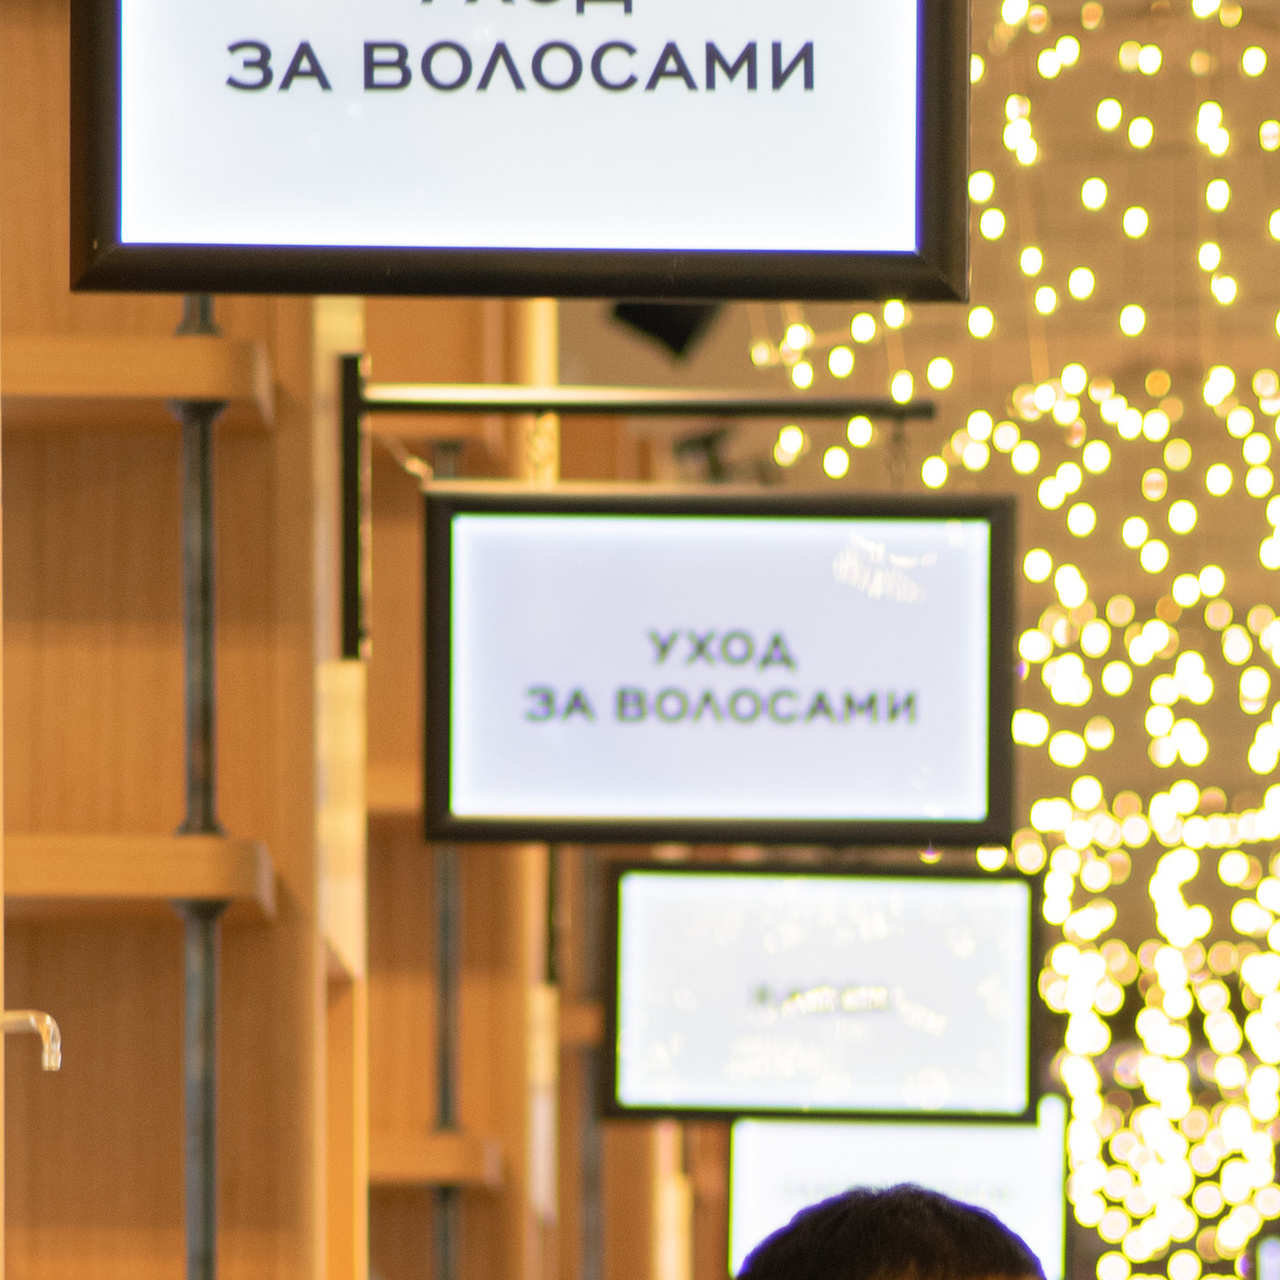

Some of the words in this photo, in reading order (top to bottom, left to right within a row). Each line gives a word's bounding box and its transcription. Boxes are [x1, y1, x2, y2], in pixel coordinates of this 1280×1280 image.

[224, 38, 333, 93] ЗА
[361, 39, 816, 93] ВОЛОСАМИ
[646, 627, 799, 672] УХОД
[523, 683, 597, 724] ЗА
[611, 684, 919, 726] ВОЛОСАМИ
